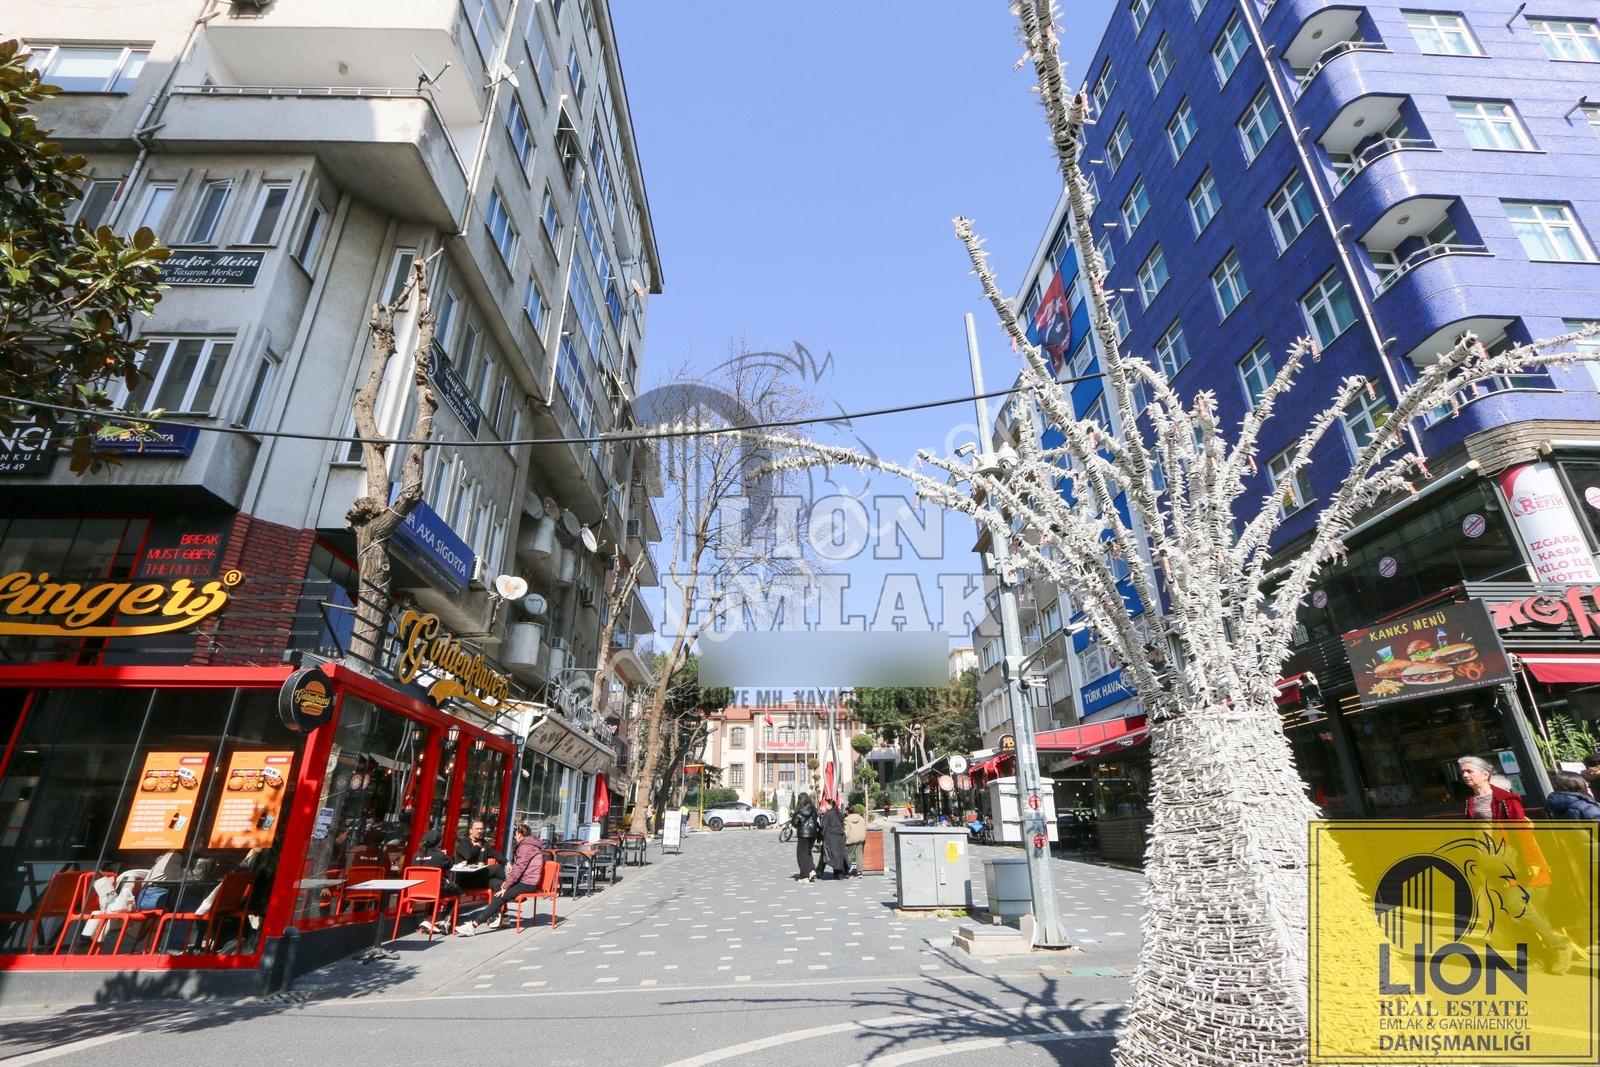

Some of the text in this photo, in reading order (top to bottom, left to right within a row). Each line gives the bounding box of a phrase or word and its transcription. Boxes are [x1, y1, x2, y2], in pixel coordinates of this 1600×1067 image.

[158, 255, 259, 267] uaför Metin
[173, 267, 208, 276] Tasarım
[209, 268, 244, 277] Merkezi
[181, 534, 219, 545] BREAK
[416, 523, 435, 548] AXA
[147, 549, 180, 559] MUST
[1538, 547, 1582, 561] KASAP
[1369, 612, 1446, 642] KANKS MENÜ
[400, 609, 510, 701] Goldenfingers
[1084, 681, 1121, 704] TÜRK HAVA
